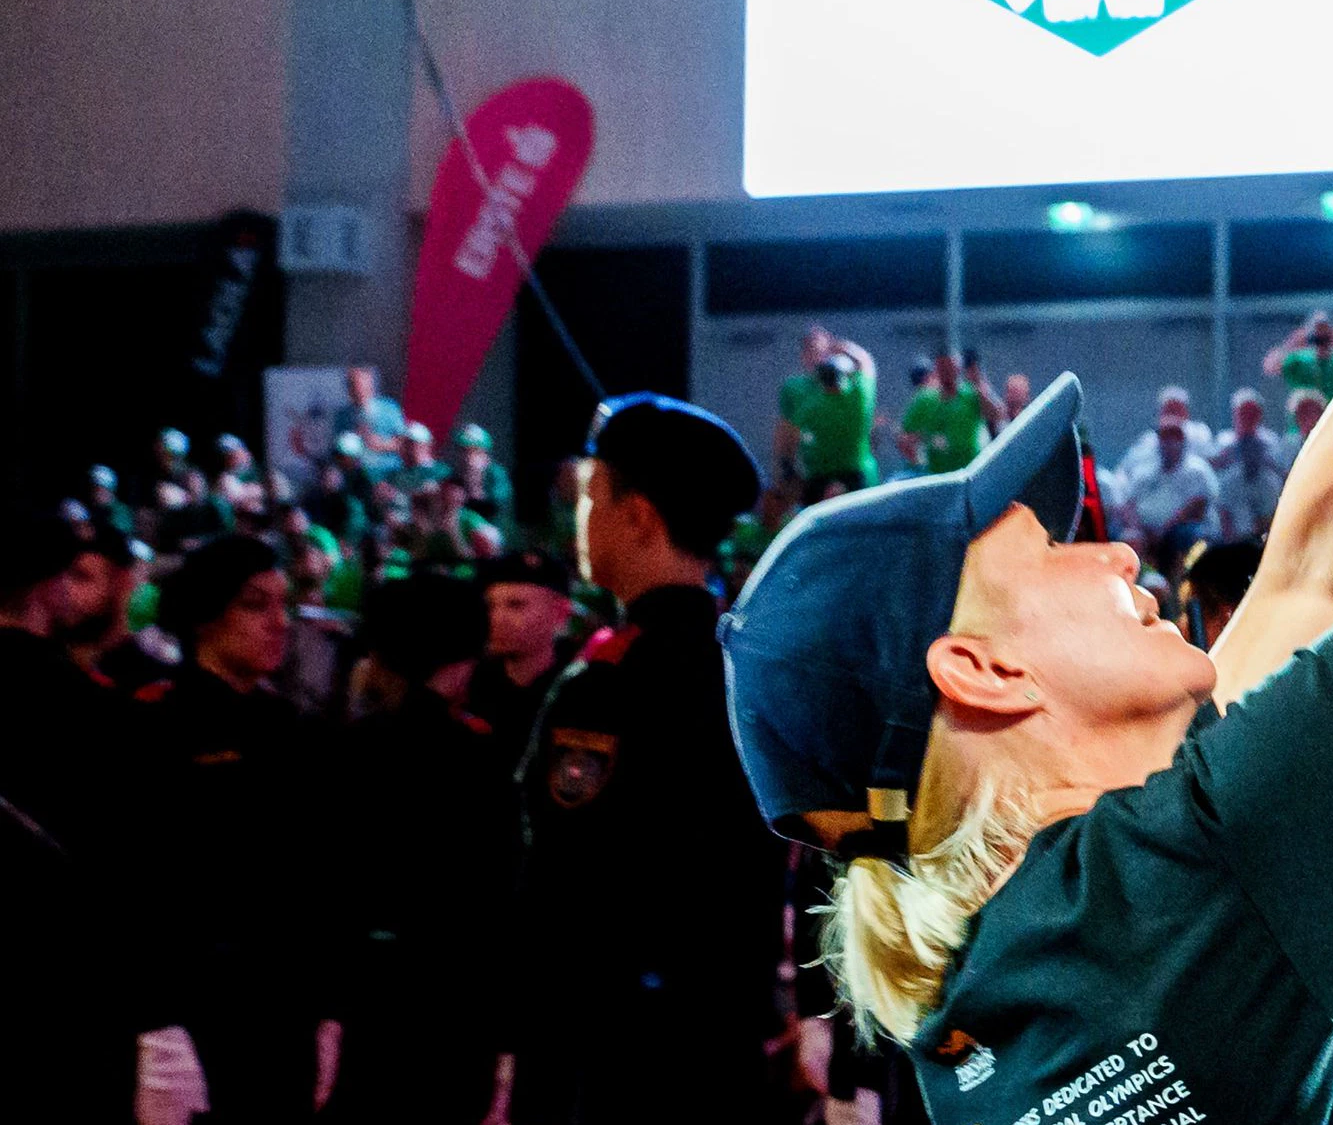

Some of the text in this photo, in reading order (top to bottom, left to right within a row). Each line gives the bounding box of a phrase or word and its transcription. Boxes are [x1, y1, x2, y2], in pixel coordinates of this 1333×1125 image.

[1042, 1055, 1125, 1116] DEDICATED
[1126, 1032, 1158, 1057] TO
[1088, 1055, 1176, 1117] OLYMPICS
